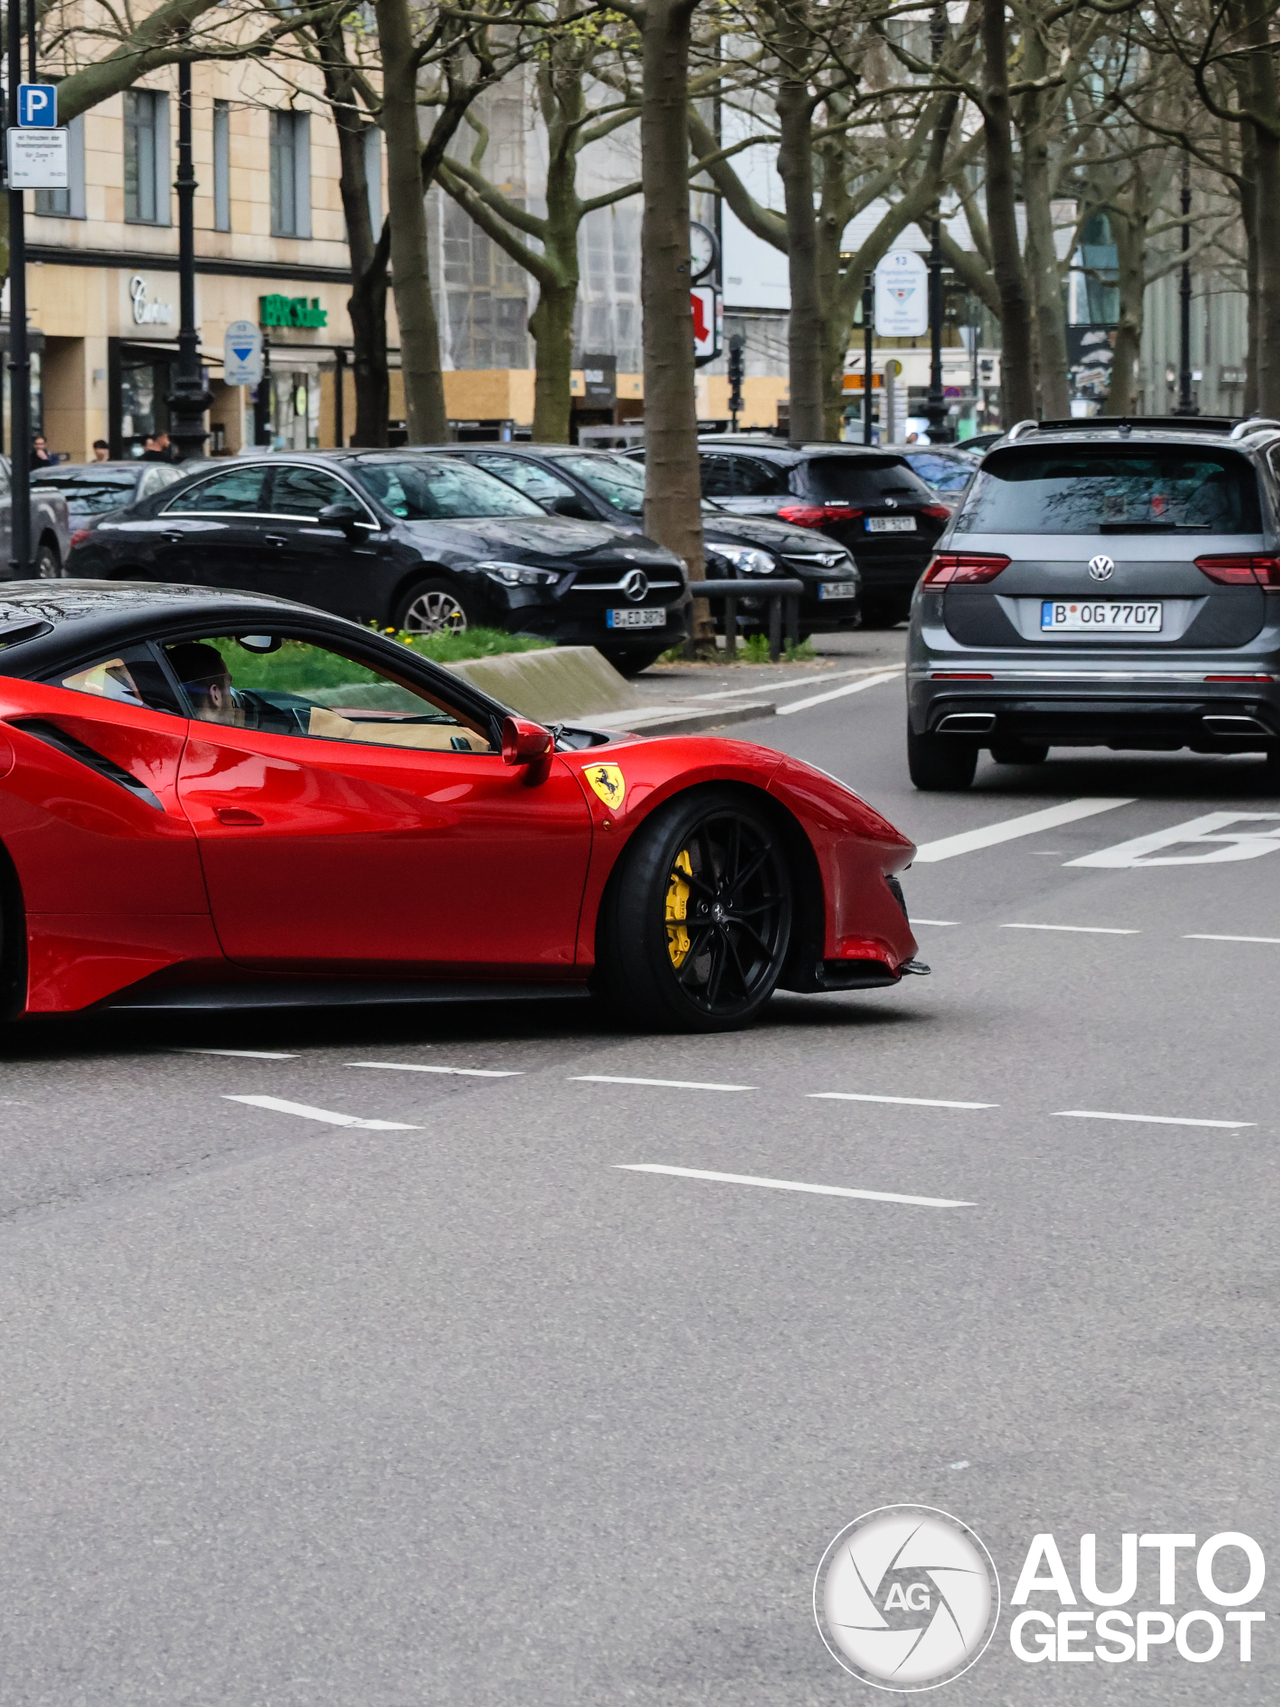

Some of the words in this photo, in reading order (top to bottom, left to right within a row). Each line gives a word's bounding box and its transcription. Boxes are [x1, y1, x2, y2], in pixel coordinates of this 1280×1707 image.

[26, 89, 48, 122] P
[895, 256, 908, 266] 13
[1055, 605, 1067, 624] B
[1080, 605, 1106, 623] OG
[1110, 605, 1159, 624] 7707
